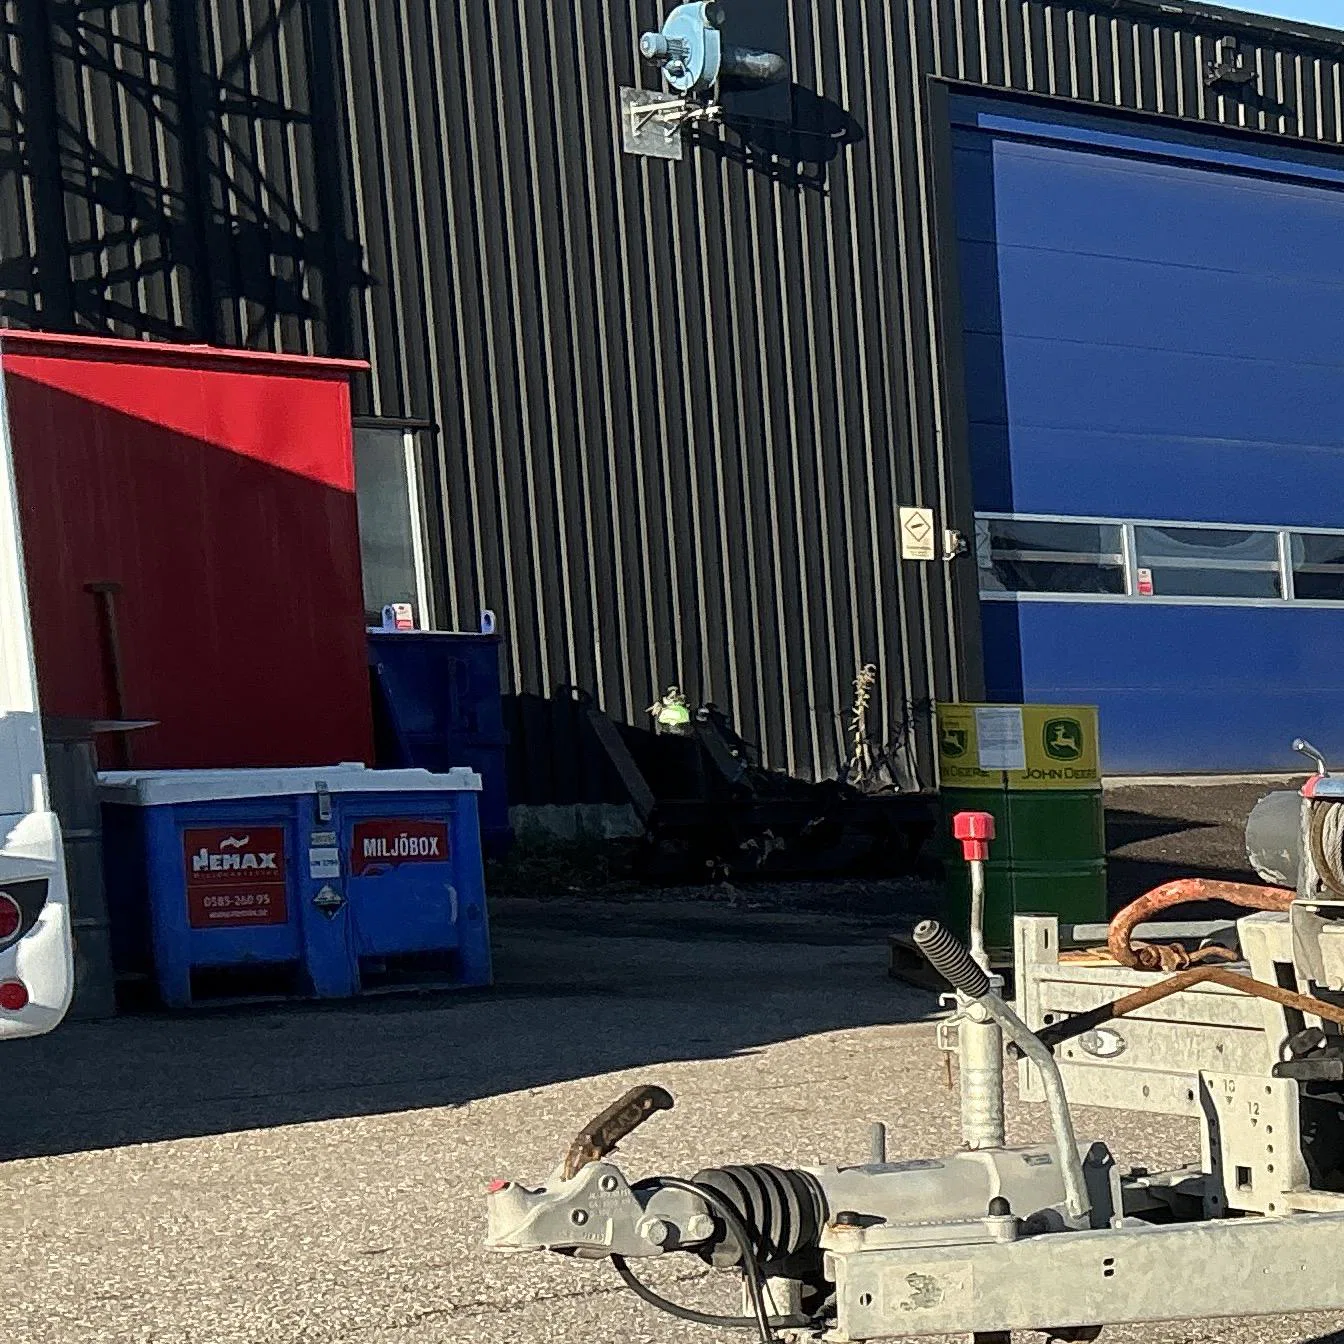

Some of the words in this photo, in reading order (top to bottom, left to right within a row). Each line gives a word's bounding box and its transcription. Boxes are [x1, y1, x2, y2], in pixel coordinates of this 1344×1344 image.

[1021, 767, 1062, 780] JOHN
[363, 832, 440, 858] MILJÖBOX
[1223, 1079, 1235, 1093] 10
[1247, 1101, 1260, 1116] 12
